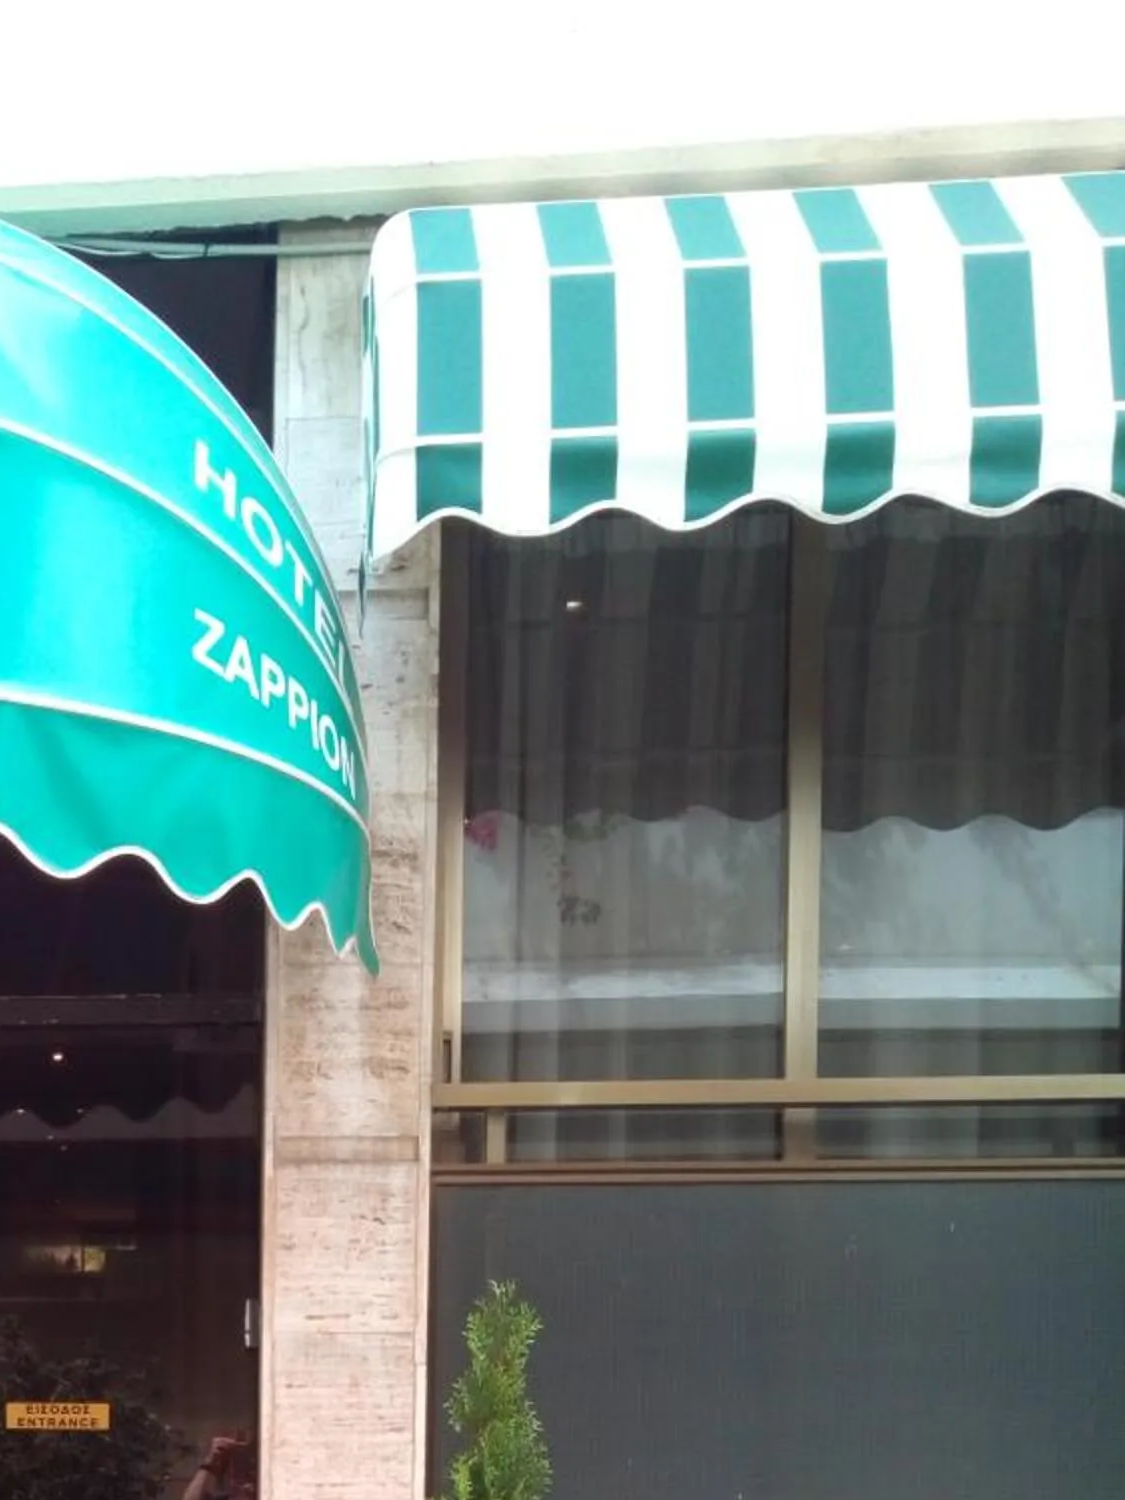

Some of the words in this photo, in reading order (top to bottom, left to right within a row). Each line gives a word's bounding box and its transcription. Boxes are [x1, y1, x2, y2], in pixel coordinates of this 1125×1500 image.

[193, 439, 347, 686] HOTEL
[191, 608, 356, 800] ZAPPION
[16, 1417, 100, 1427] ENTRANCE
